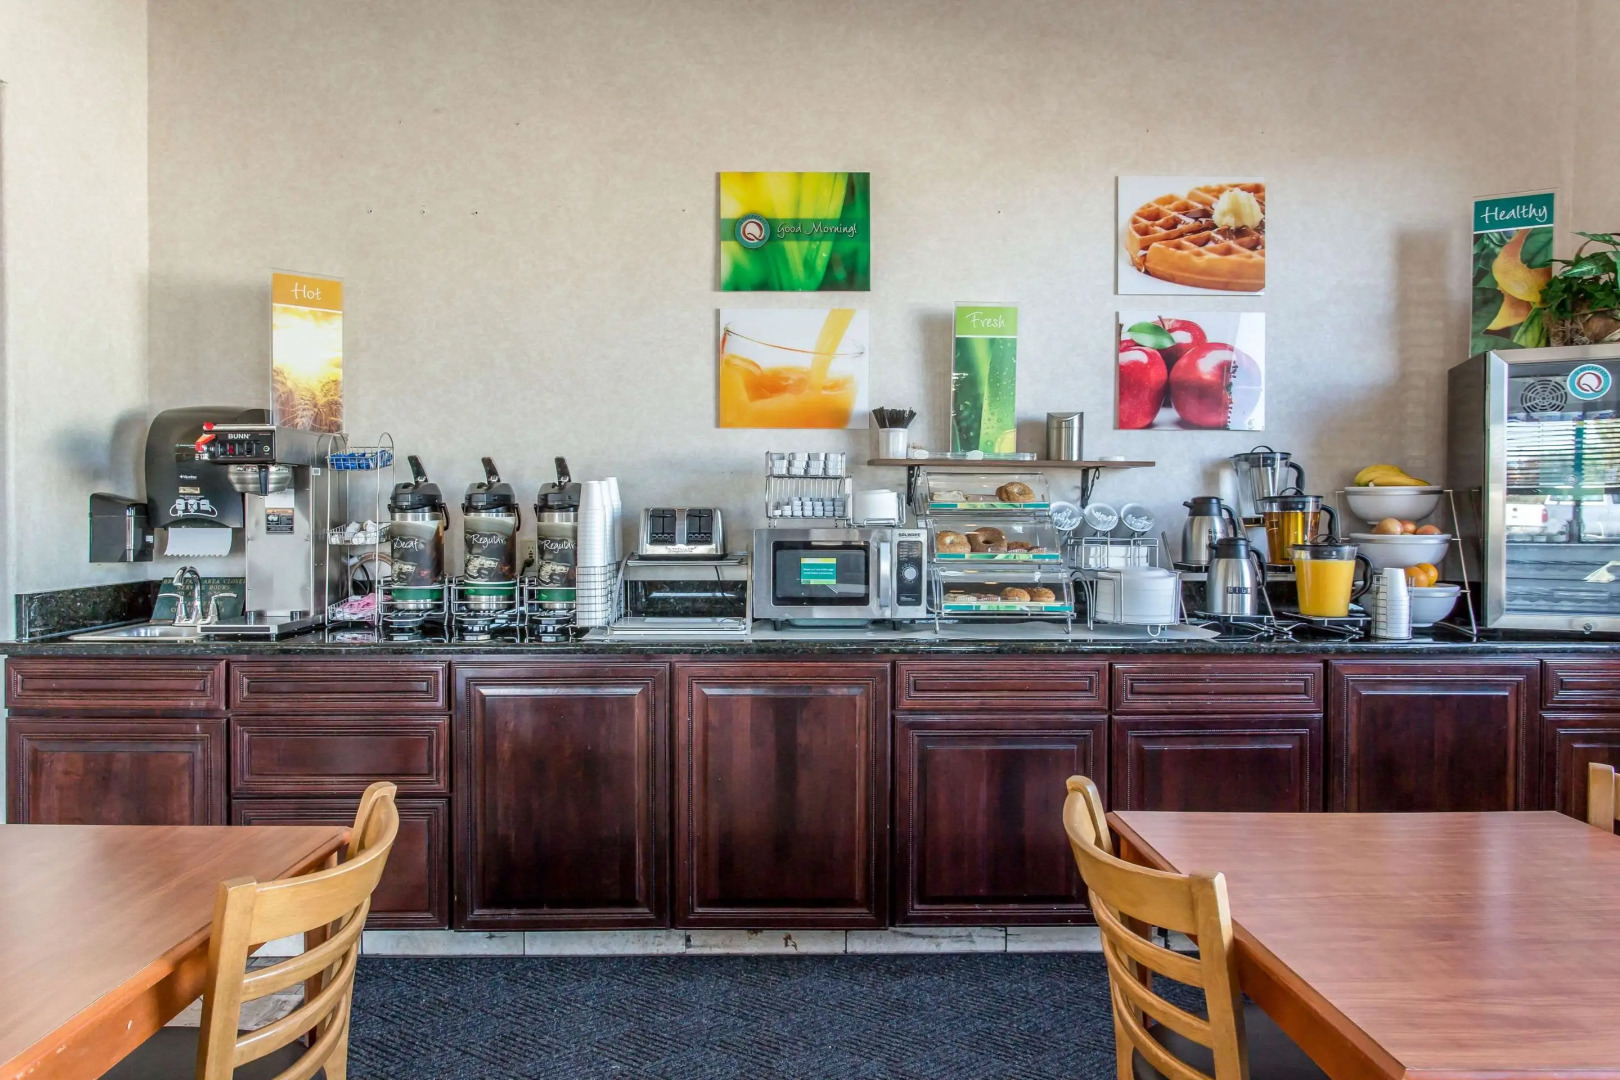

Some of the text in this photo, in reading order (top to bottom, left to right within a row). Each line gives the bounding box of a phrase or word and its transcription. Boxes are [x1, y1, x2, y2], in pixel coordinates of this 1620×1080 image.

[1480, 203, 1548, 223] Healthy
[777, 221, 857, 239] Good Morning!
[289, 282, 322, 300] Hot
[964, 311, 1006, 328] Fresh
[393, 536, 419, 552] Decaf
[470, 532, 507, 550] Regular
[542, 539, 576, 554] Regular
